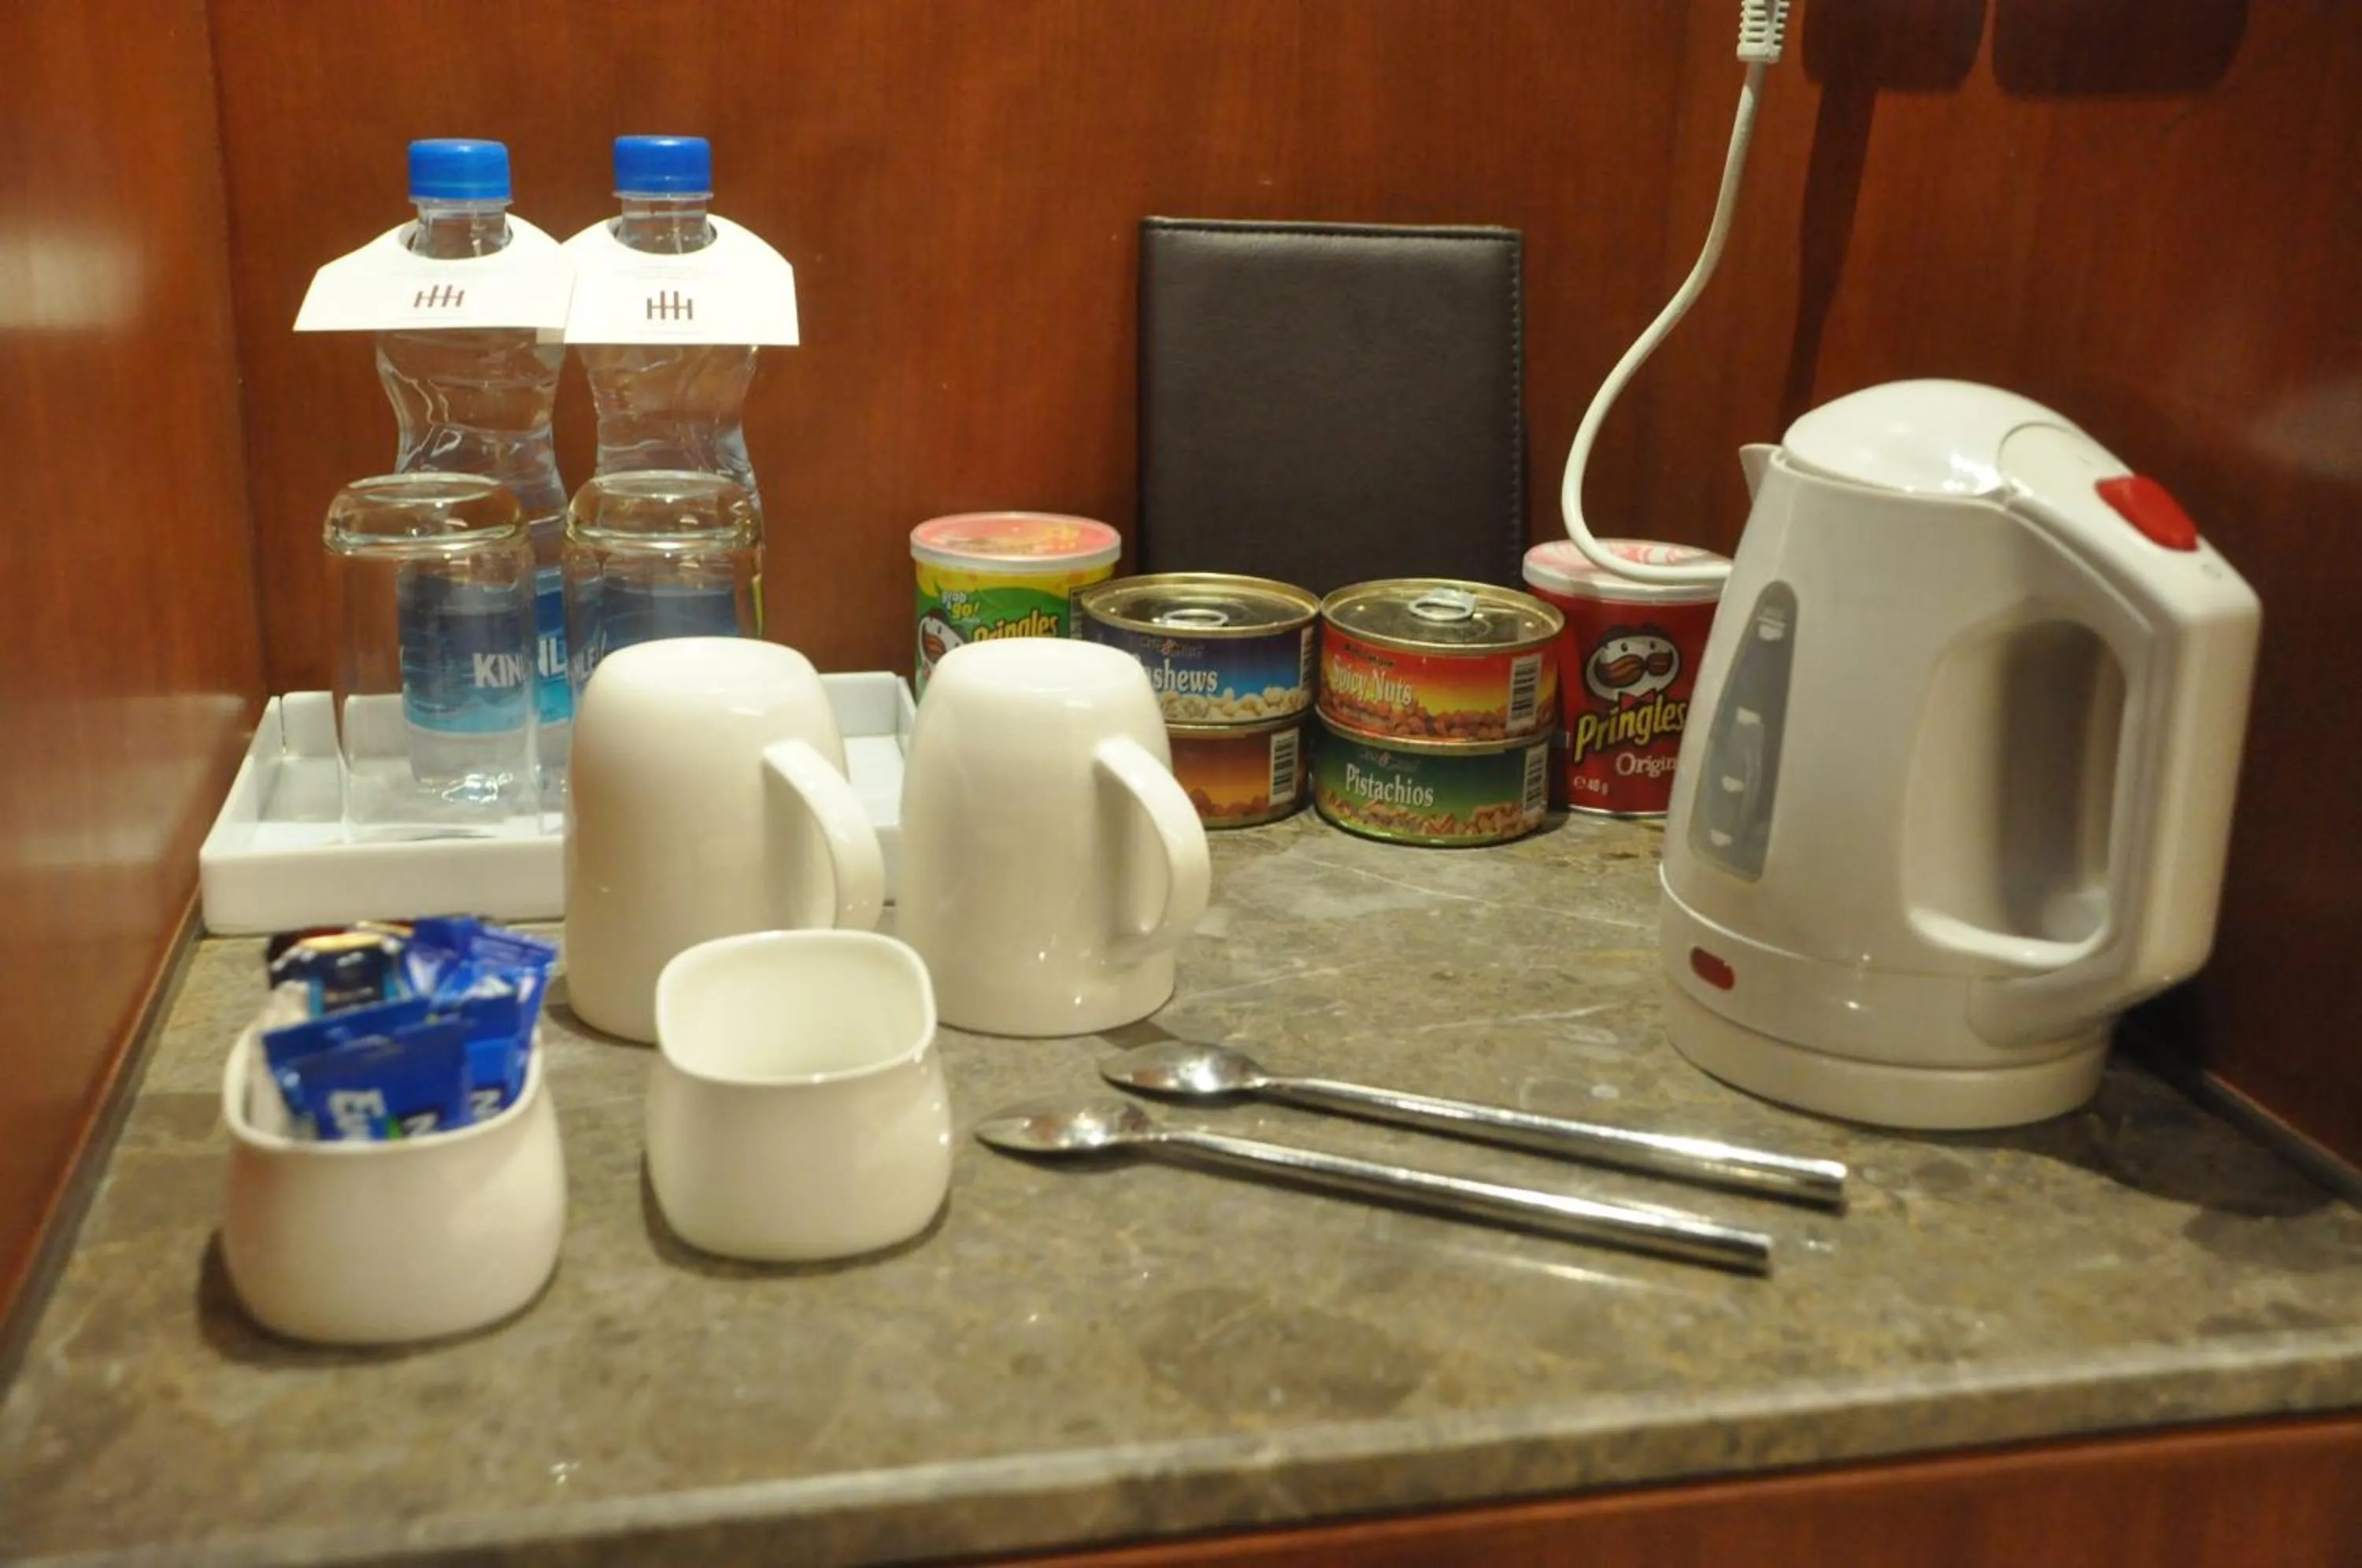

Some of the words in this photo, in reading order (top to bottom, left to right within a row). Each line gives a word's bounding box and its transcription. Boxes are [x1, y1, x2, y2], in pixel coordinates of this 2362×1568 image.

[1144, 658, 1218, 693] shews
[1372, 668, 1412, 706] Nuts
[1575, 694, 1686, 763] Pringles
[1616, 752, 1677, 778] Origin
[1346, 762, 1435, 808] Pistachios
